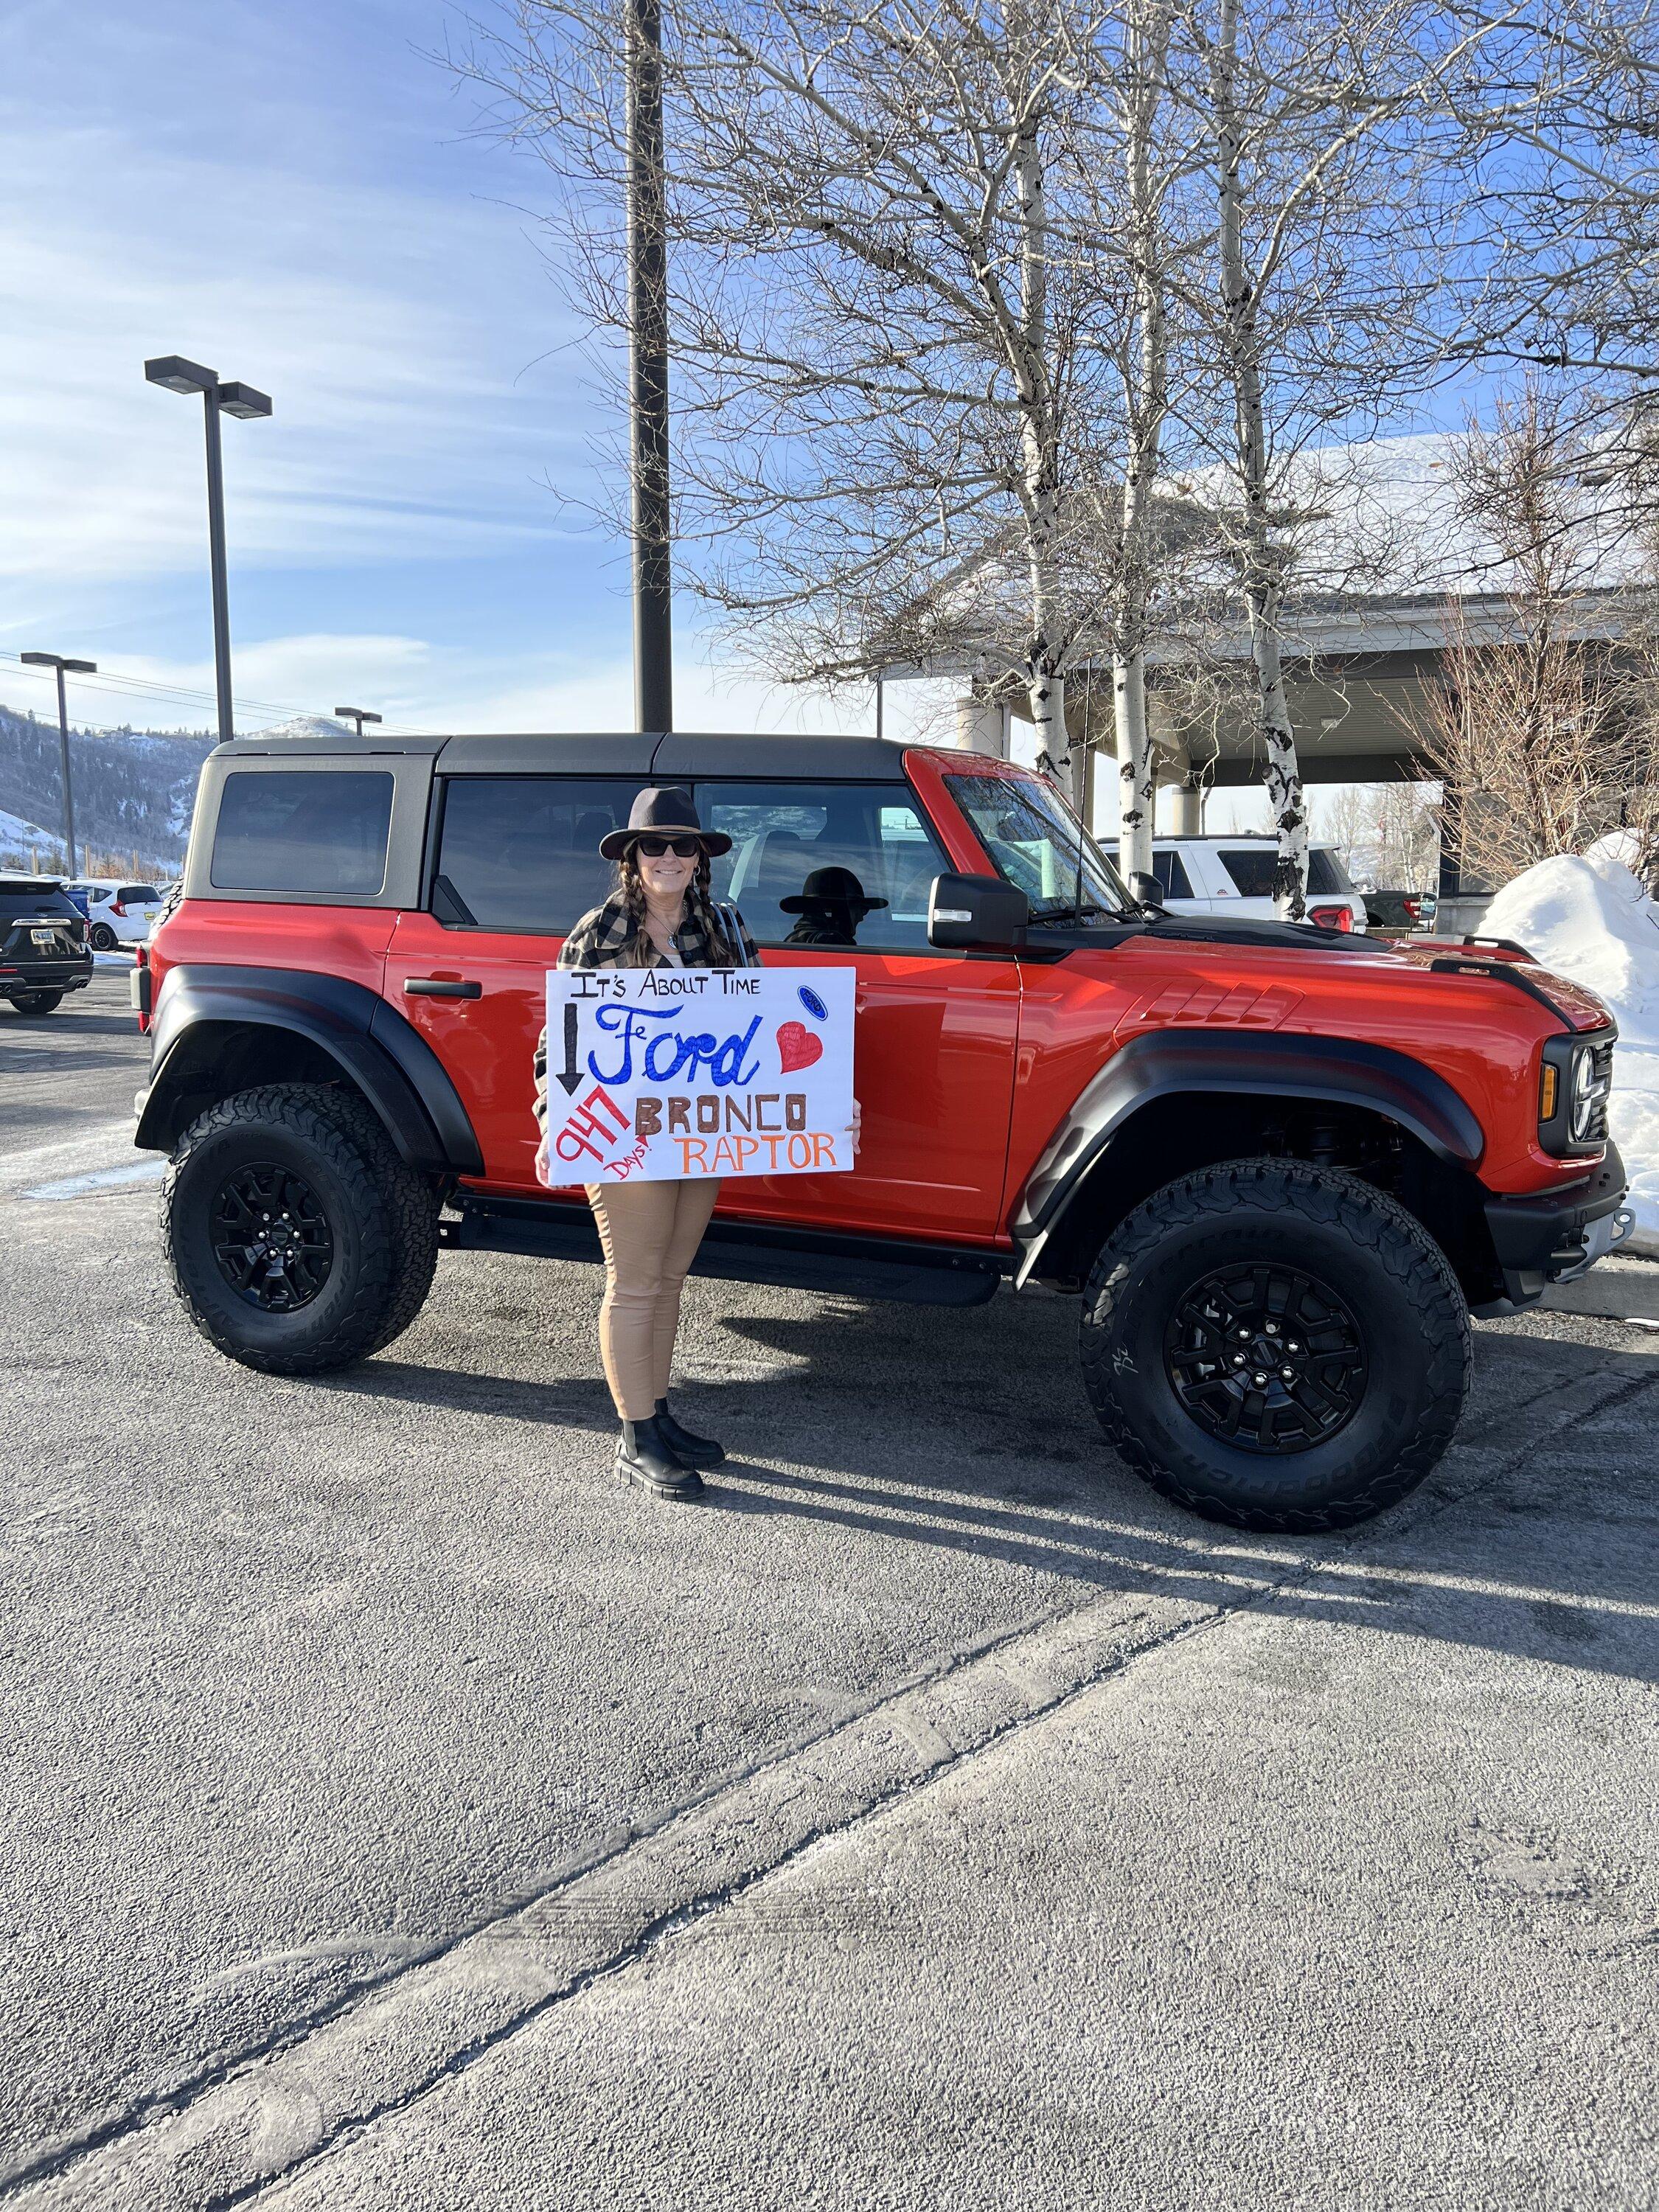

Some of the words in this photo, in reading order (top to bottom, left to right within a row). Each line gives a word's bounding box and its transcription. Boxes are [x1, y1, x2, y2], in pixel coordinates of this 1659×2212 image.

[638, 969, 709, 998] ABOUT
[712, 970, 761, 995] TIME
[802, 990, 821, 1012] FORD
[588, 1004, 763, 1087] Ford
[556, 1085, 632, 1163] 947
[635, 1093, 806, 1135] BRONCO
[672, 1133, 837, 1174] RAPTOR
